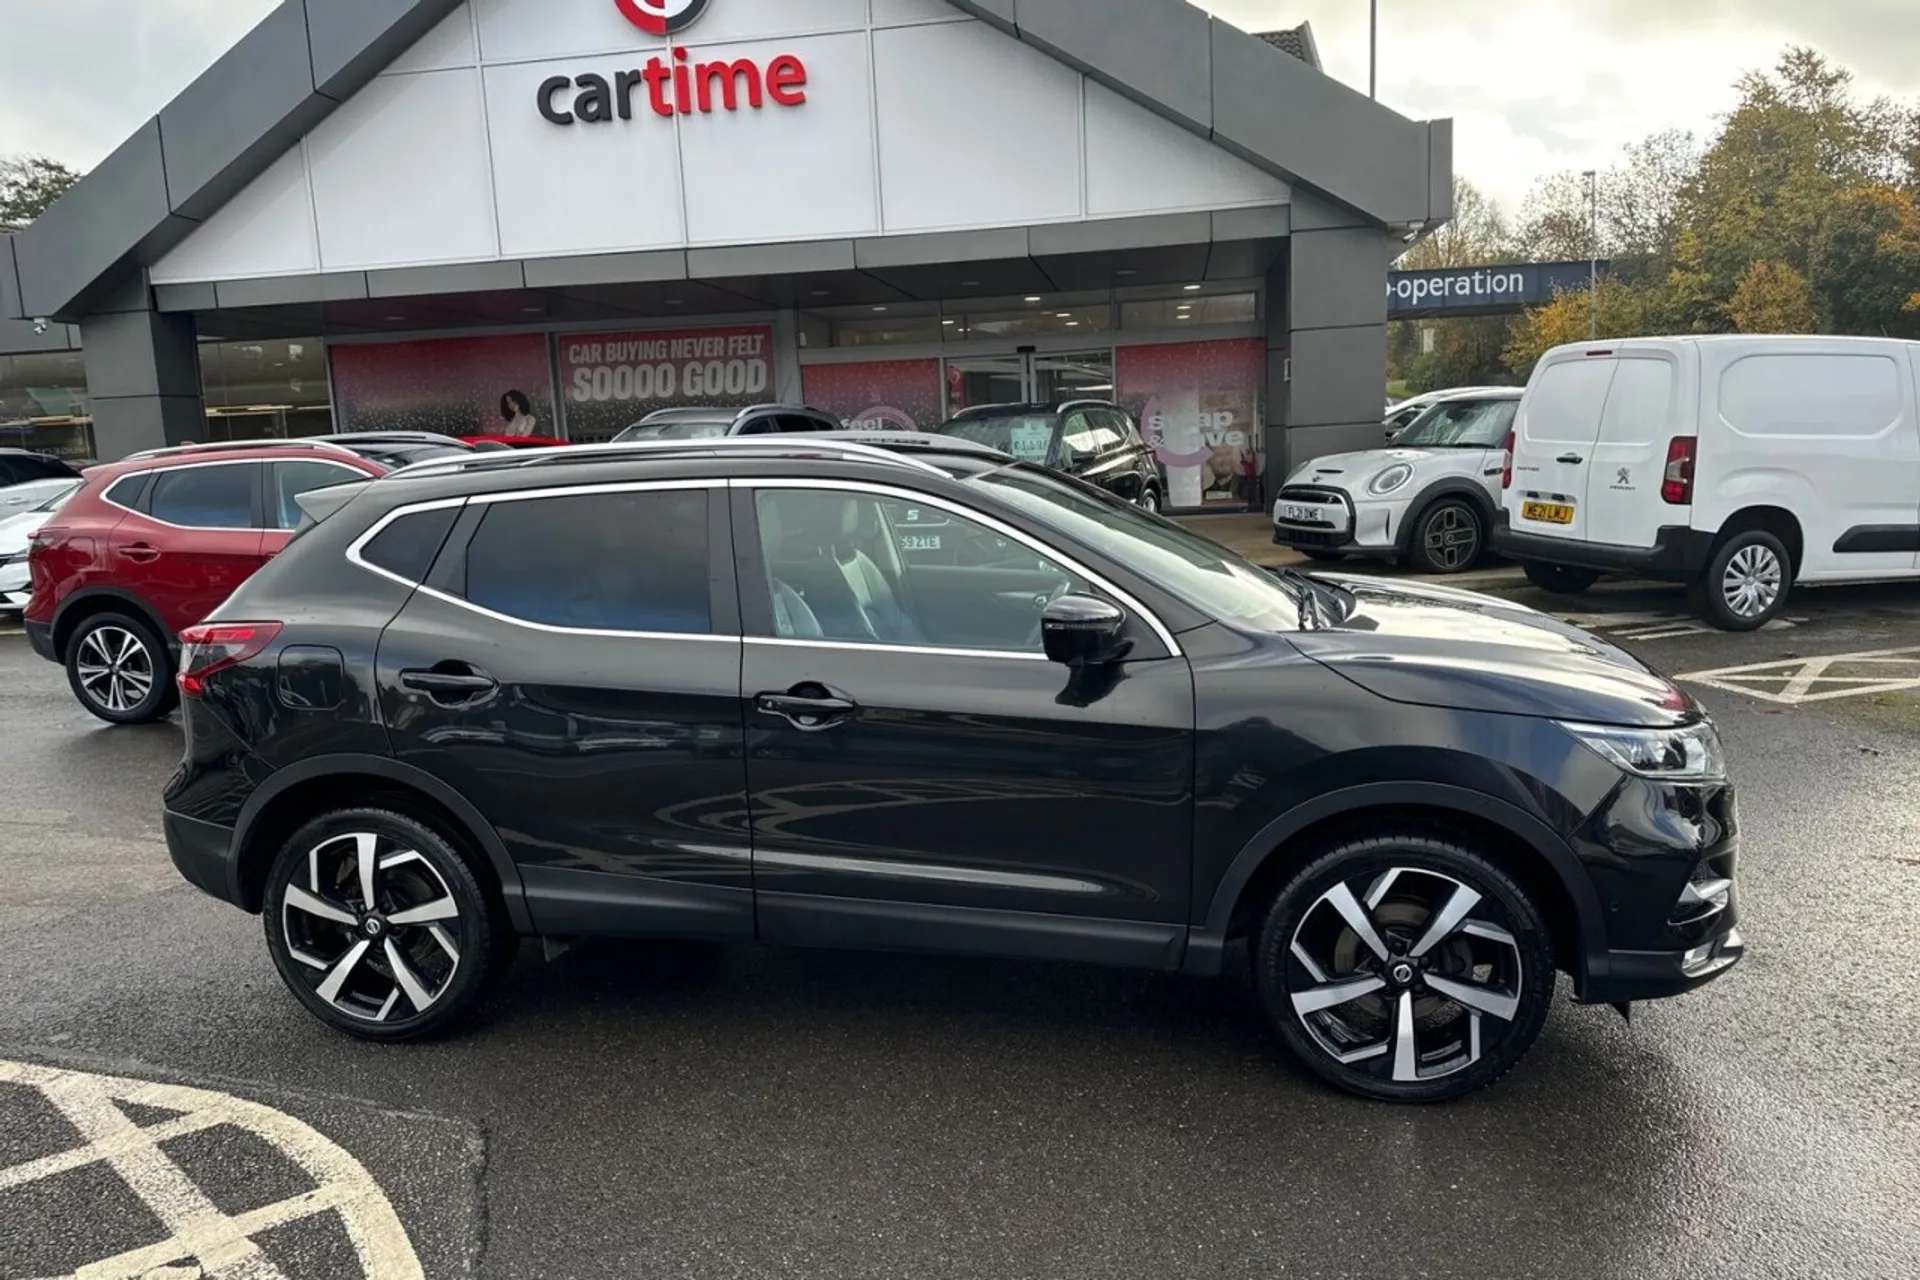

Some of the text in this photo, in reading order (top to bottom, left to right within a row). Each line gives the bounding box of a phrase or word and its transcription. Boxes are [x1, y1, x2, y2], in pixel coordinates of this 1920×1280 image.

[537, 46, 807, 125] cartime
[569, 334, 764, 364] CAR BUYING NEVER FELT
[573, 358, 767, 402] SOOOO GOOD
